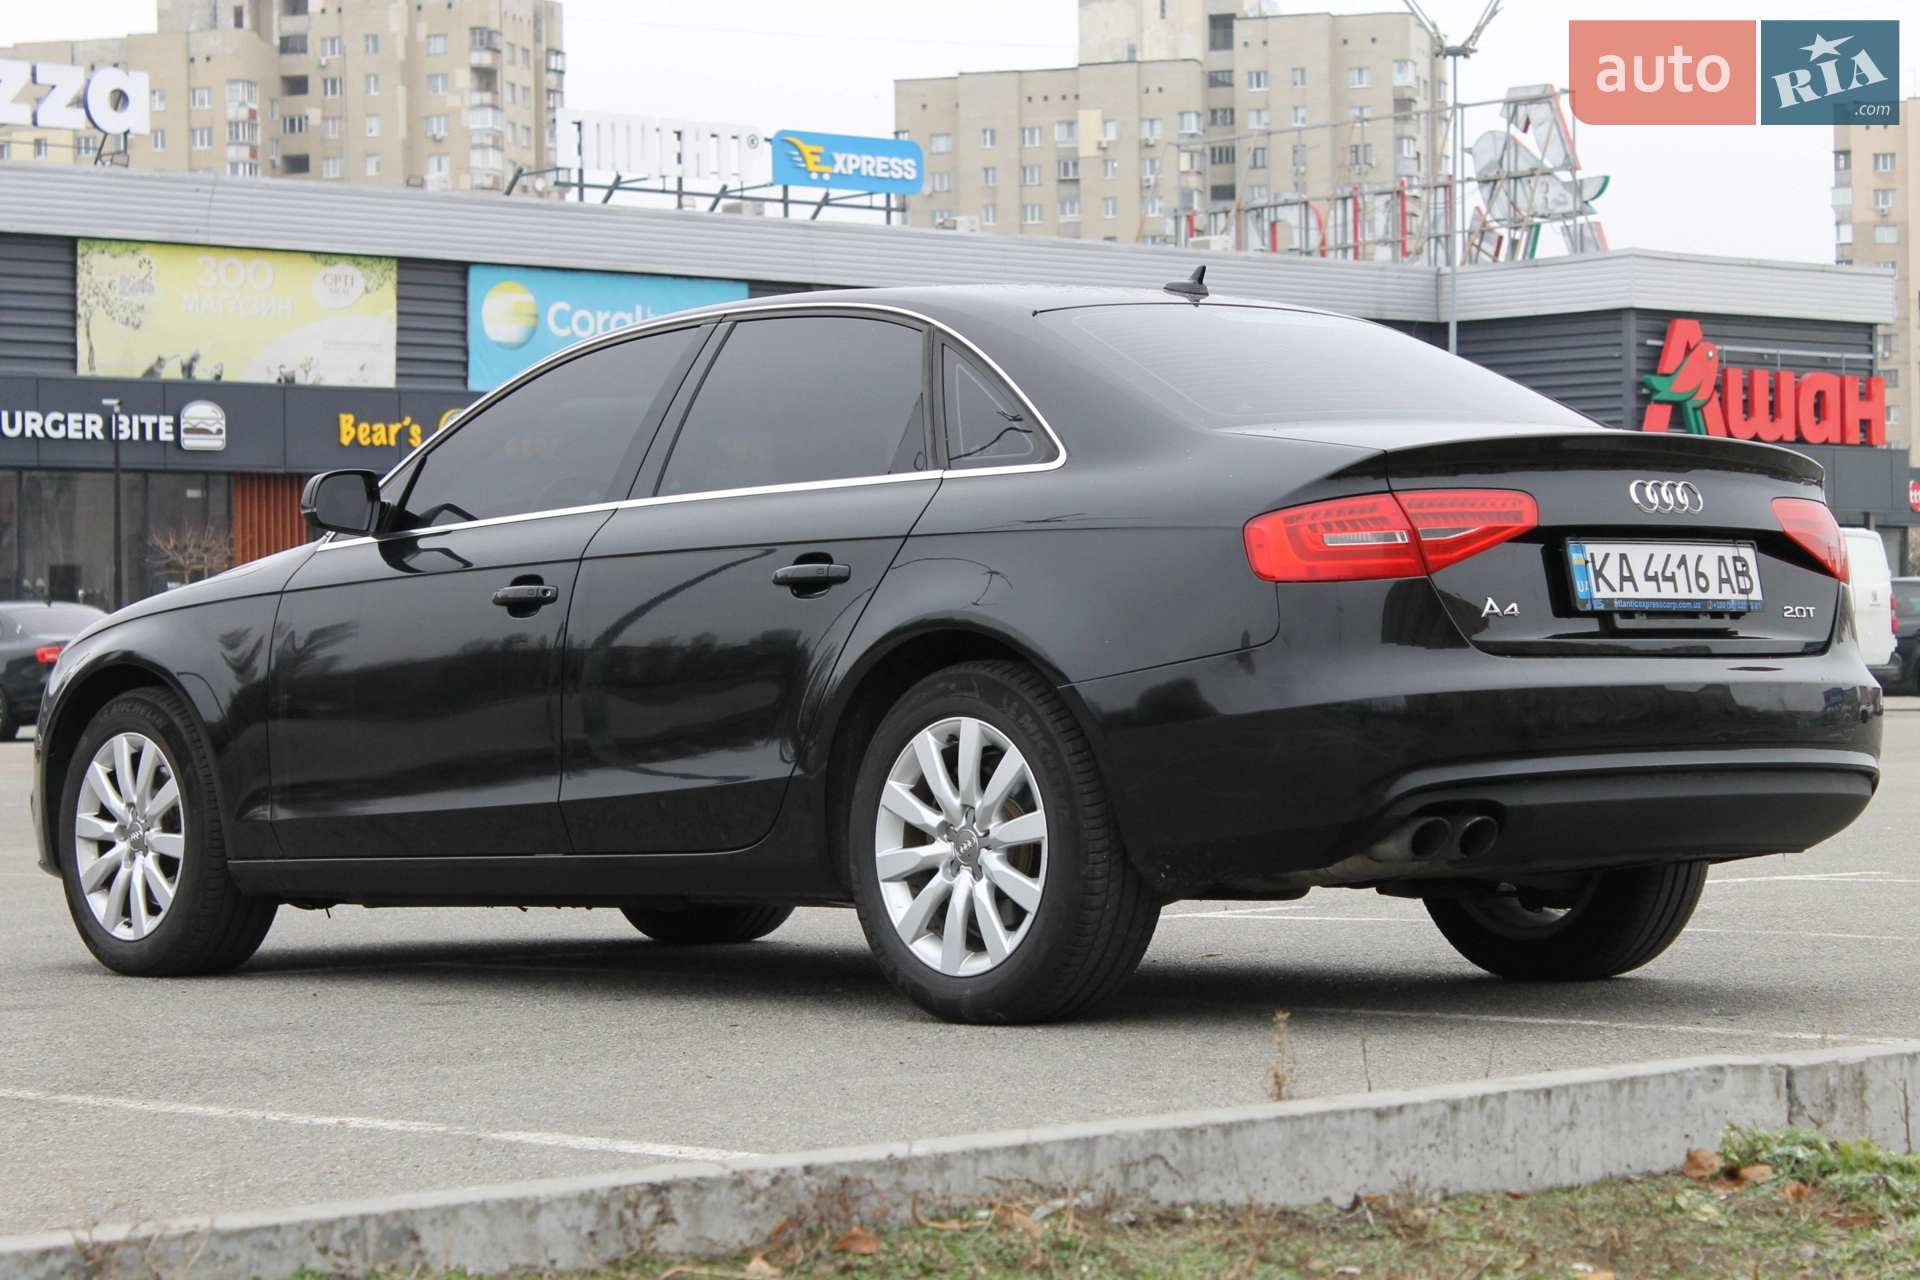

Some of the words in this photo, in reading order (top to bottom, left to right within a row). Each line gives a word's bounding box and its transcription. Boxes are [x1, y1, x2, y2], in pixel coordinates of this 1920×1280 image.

[322, 273, 354, 288] OPTI
[181, 291, 294, 319] МАГАЗИН
[112, 414, 174, 441] BITE
[339, 413, 422, 447] Bear's
[1590, 552, 1640, 593] KA
[1643, 553, 1710, 594] 4416
[1717, 555, 1754, 595] AB
[1481, 597, 1520, 617] A4
